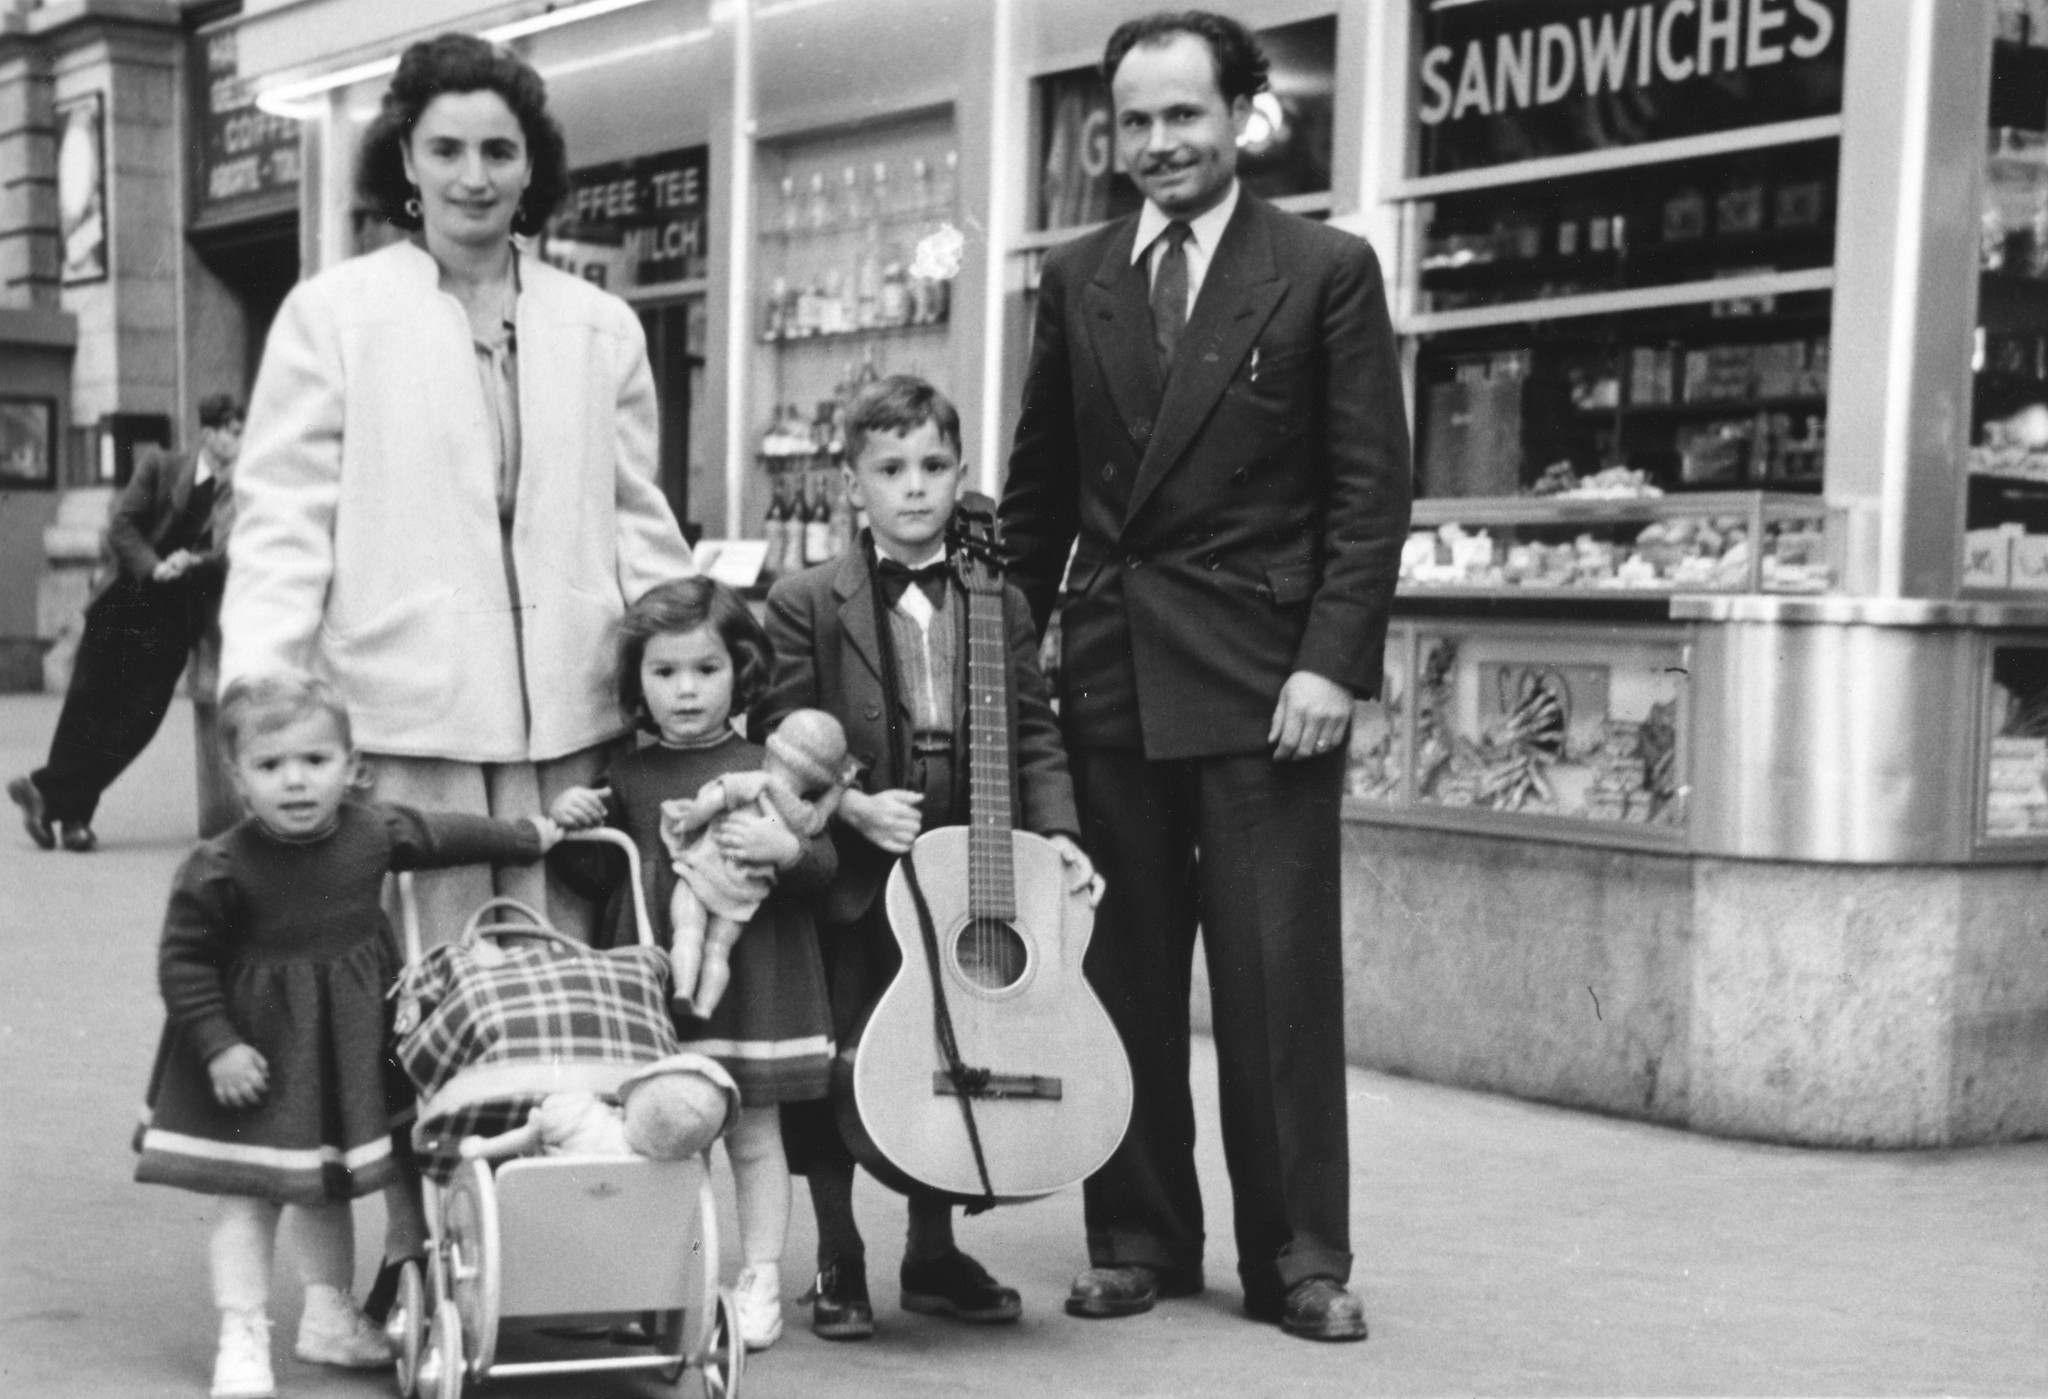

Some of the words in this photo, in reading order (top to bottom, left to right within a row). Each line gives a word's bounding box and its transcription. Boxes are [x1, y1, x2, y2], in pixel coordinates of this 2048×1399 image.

[1419, 0, 1834, 125] SANDWICHES
[566, 178, 637, 222] FFEE
[651, 167, 699, 209] TEE
[623, 217, 699, 262] MILCH
